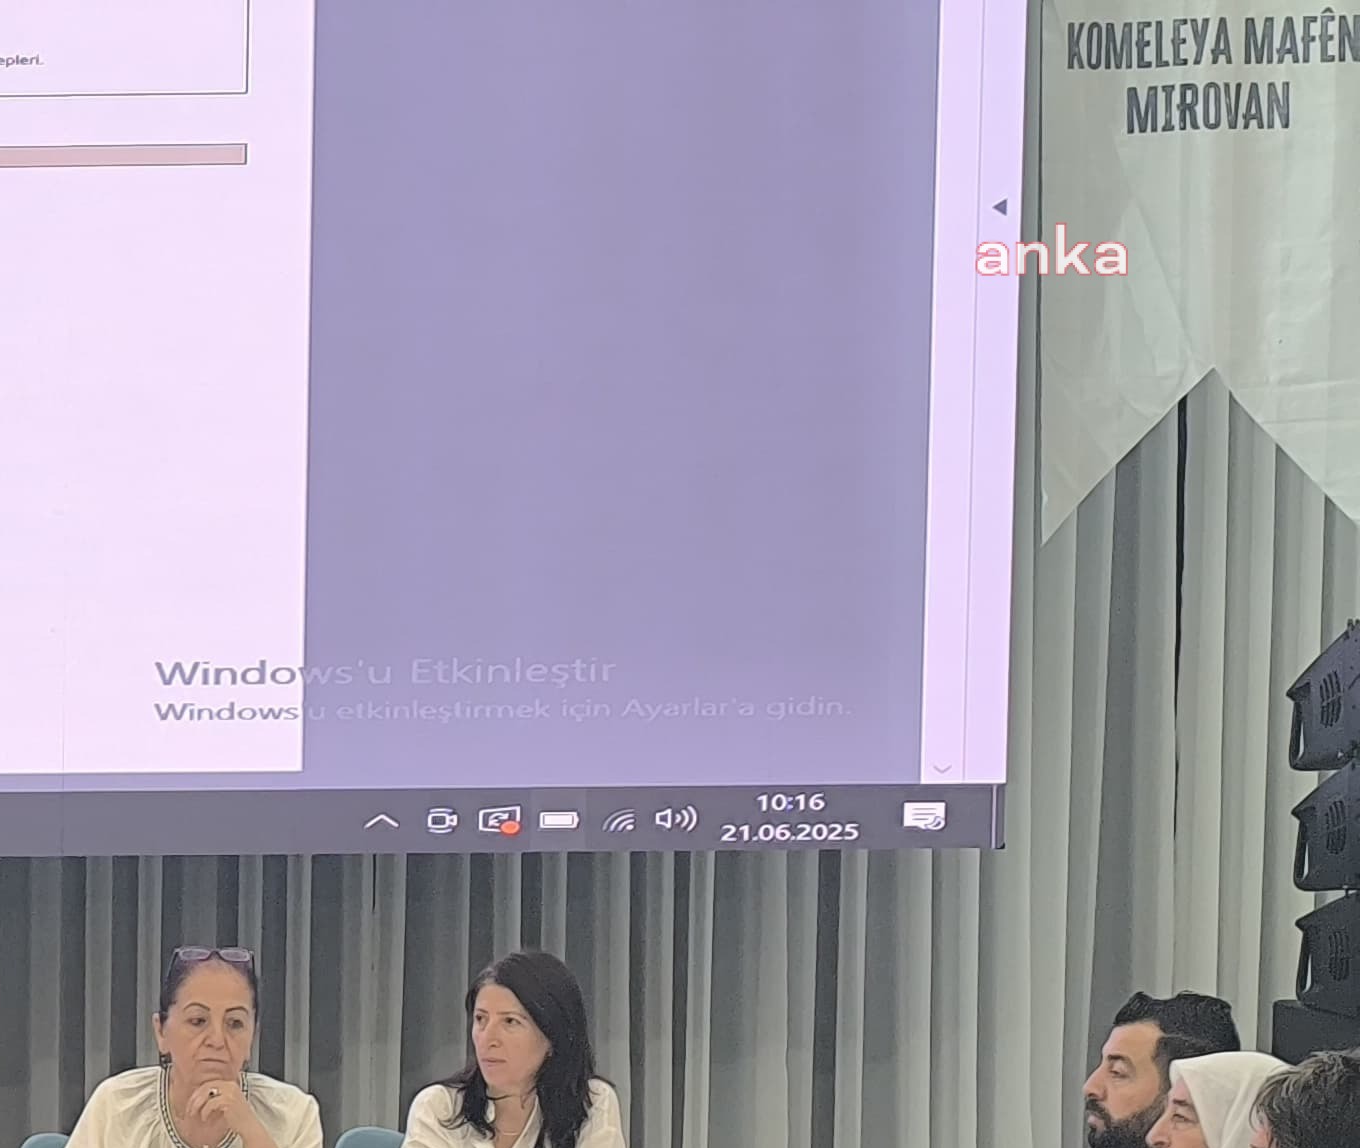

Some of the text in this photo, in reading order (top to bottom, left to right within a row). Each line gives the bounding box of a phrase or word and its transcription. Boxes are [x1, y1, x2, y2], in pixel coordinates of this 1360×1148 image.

[1067, 7, 1360, 70] KOMELEYA MAFÊN
[1126, 81, 1290, 134] MIROVAN
[154, 656, 618, 689] Windows'u Etkinleştir
[336, 699, 552, 724] etkinleştirmek
[561, 699, 612, 723] için
[621, 696, 755, 721] Ayarlar'a
[766, 696, 853, 720] gidin.
[754, 792, 827, 813] 10:16
[720, 823, 861, 842] 21.06.2025
